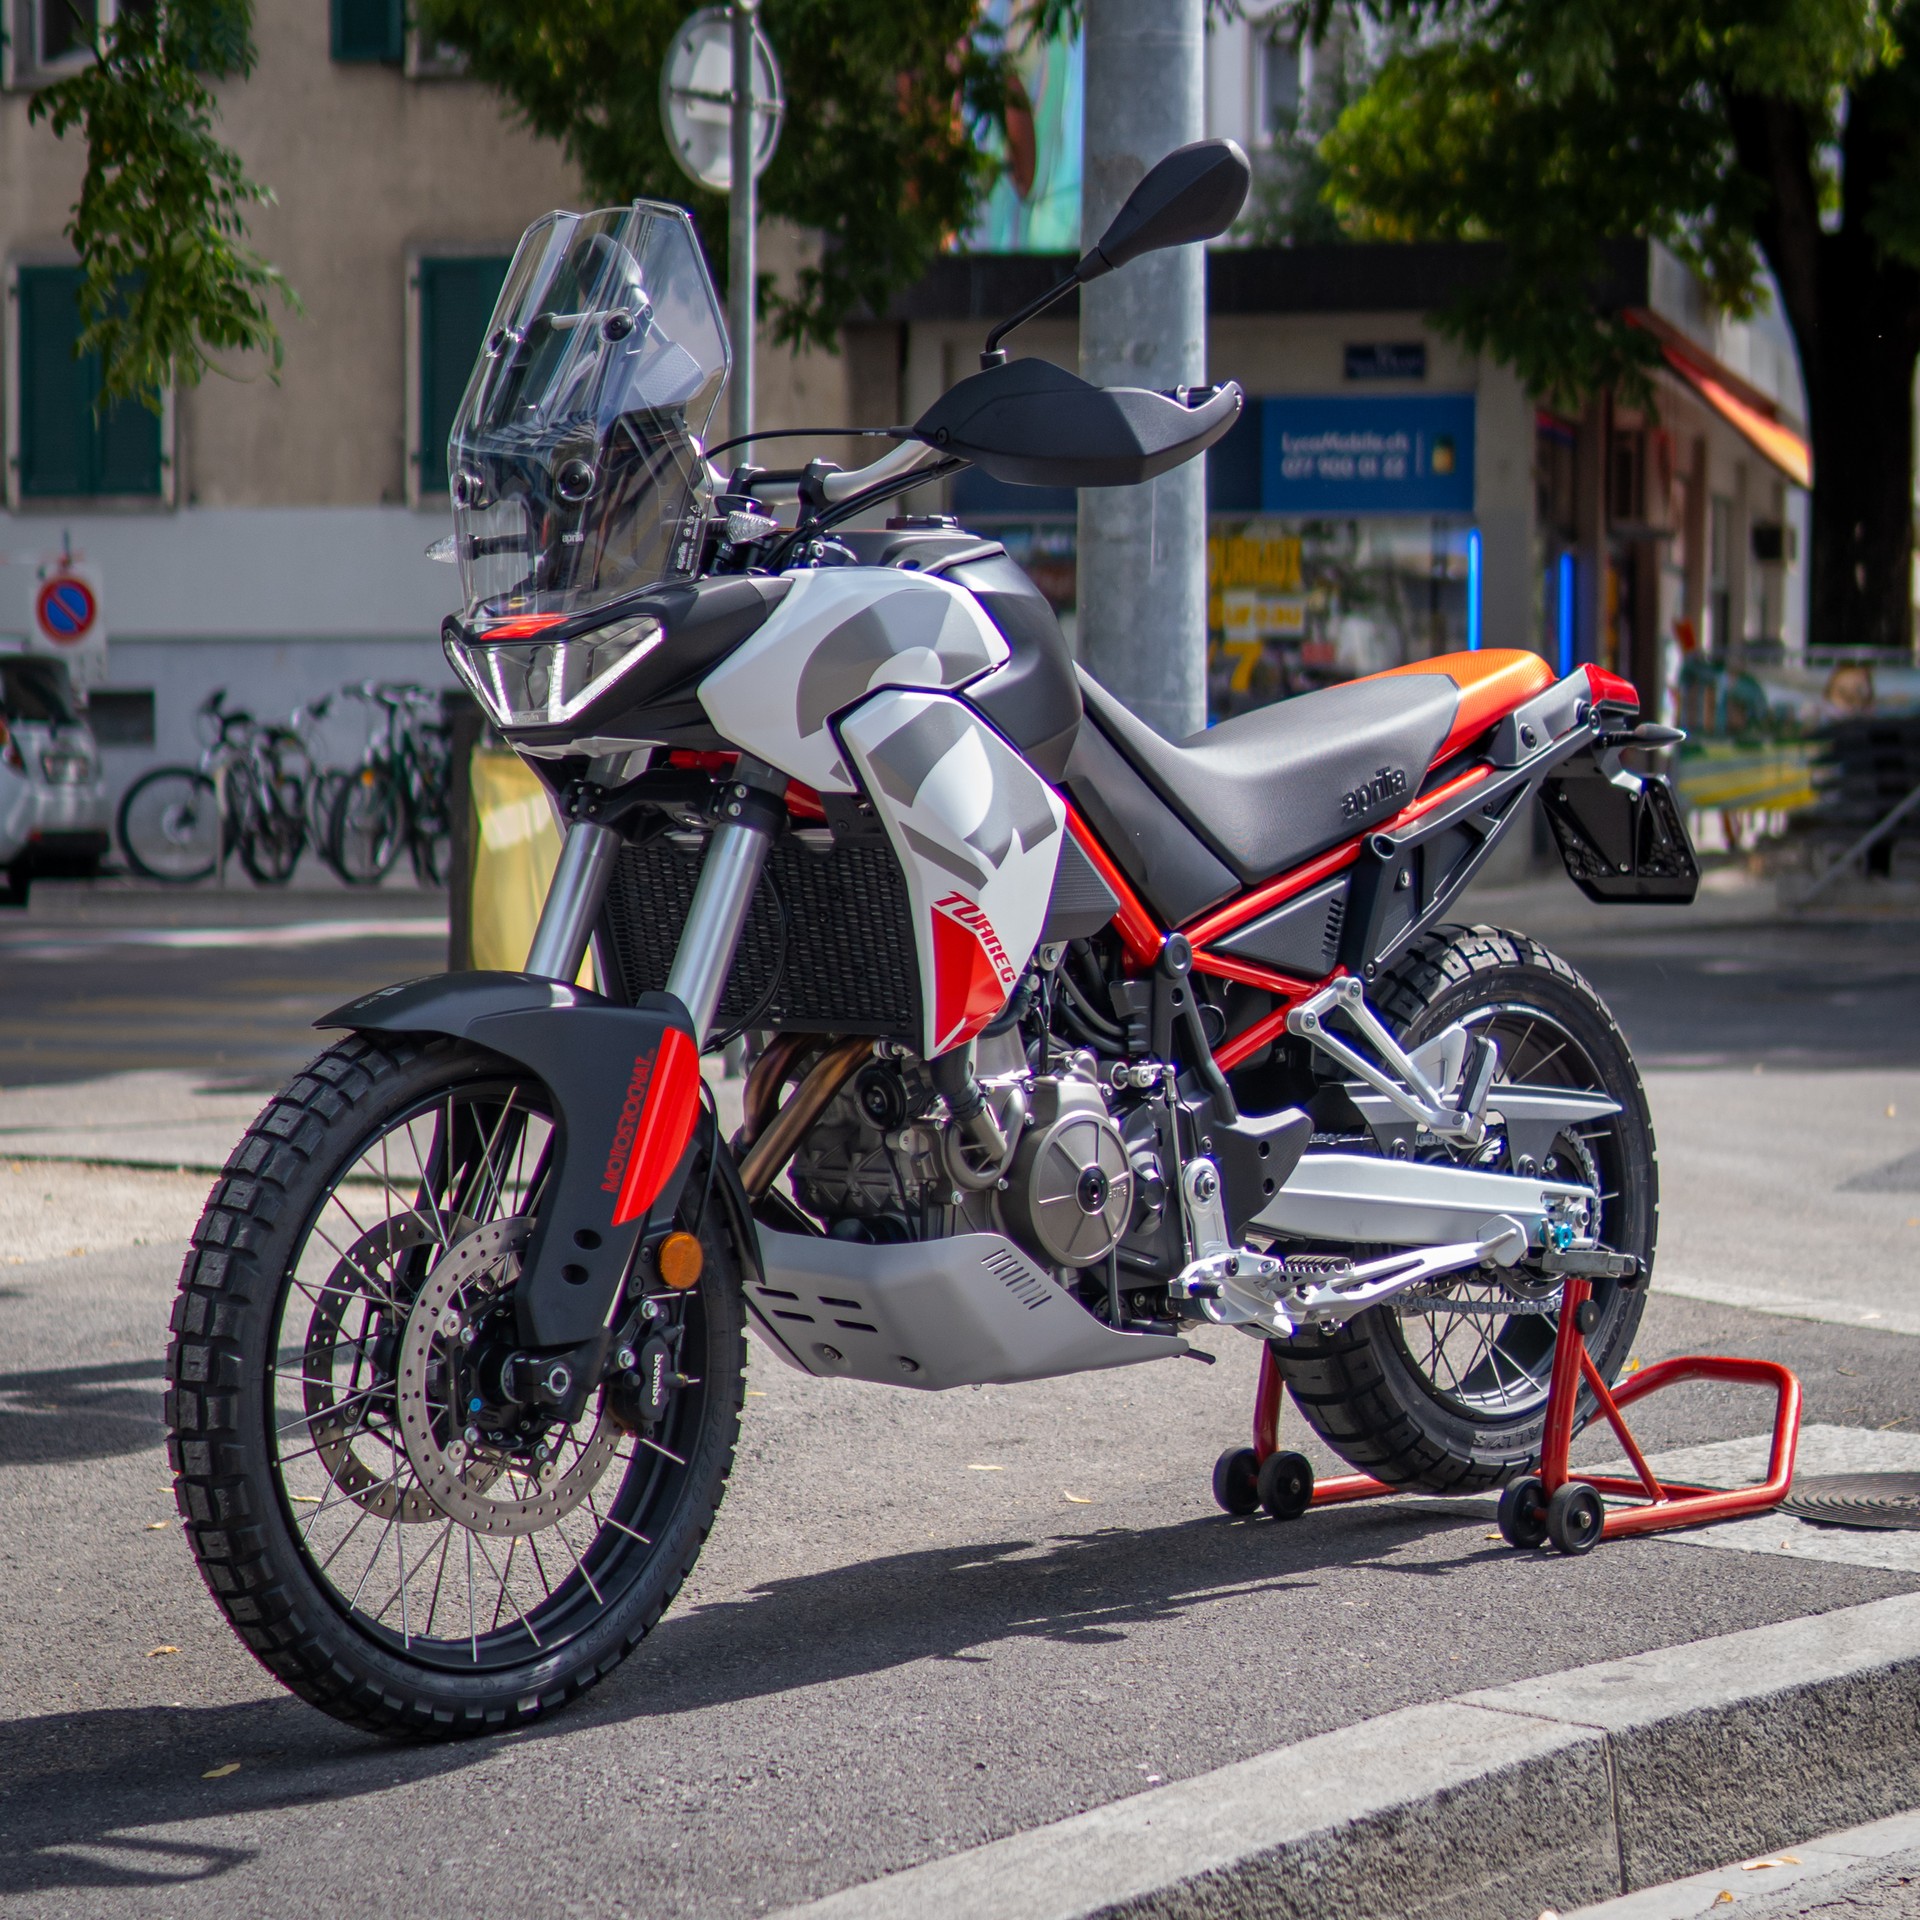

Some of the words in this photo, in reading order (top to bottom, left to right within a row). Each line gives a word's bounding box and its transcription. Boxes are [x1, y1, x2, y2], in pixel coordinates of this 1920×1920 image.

[1341, 766, 1407, 818] aprilia
[933, 889, 1017, 984] TUAREG
[651, 1353, 663, 1405] brembo
